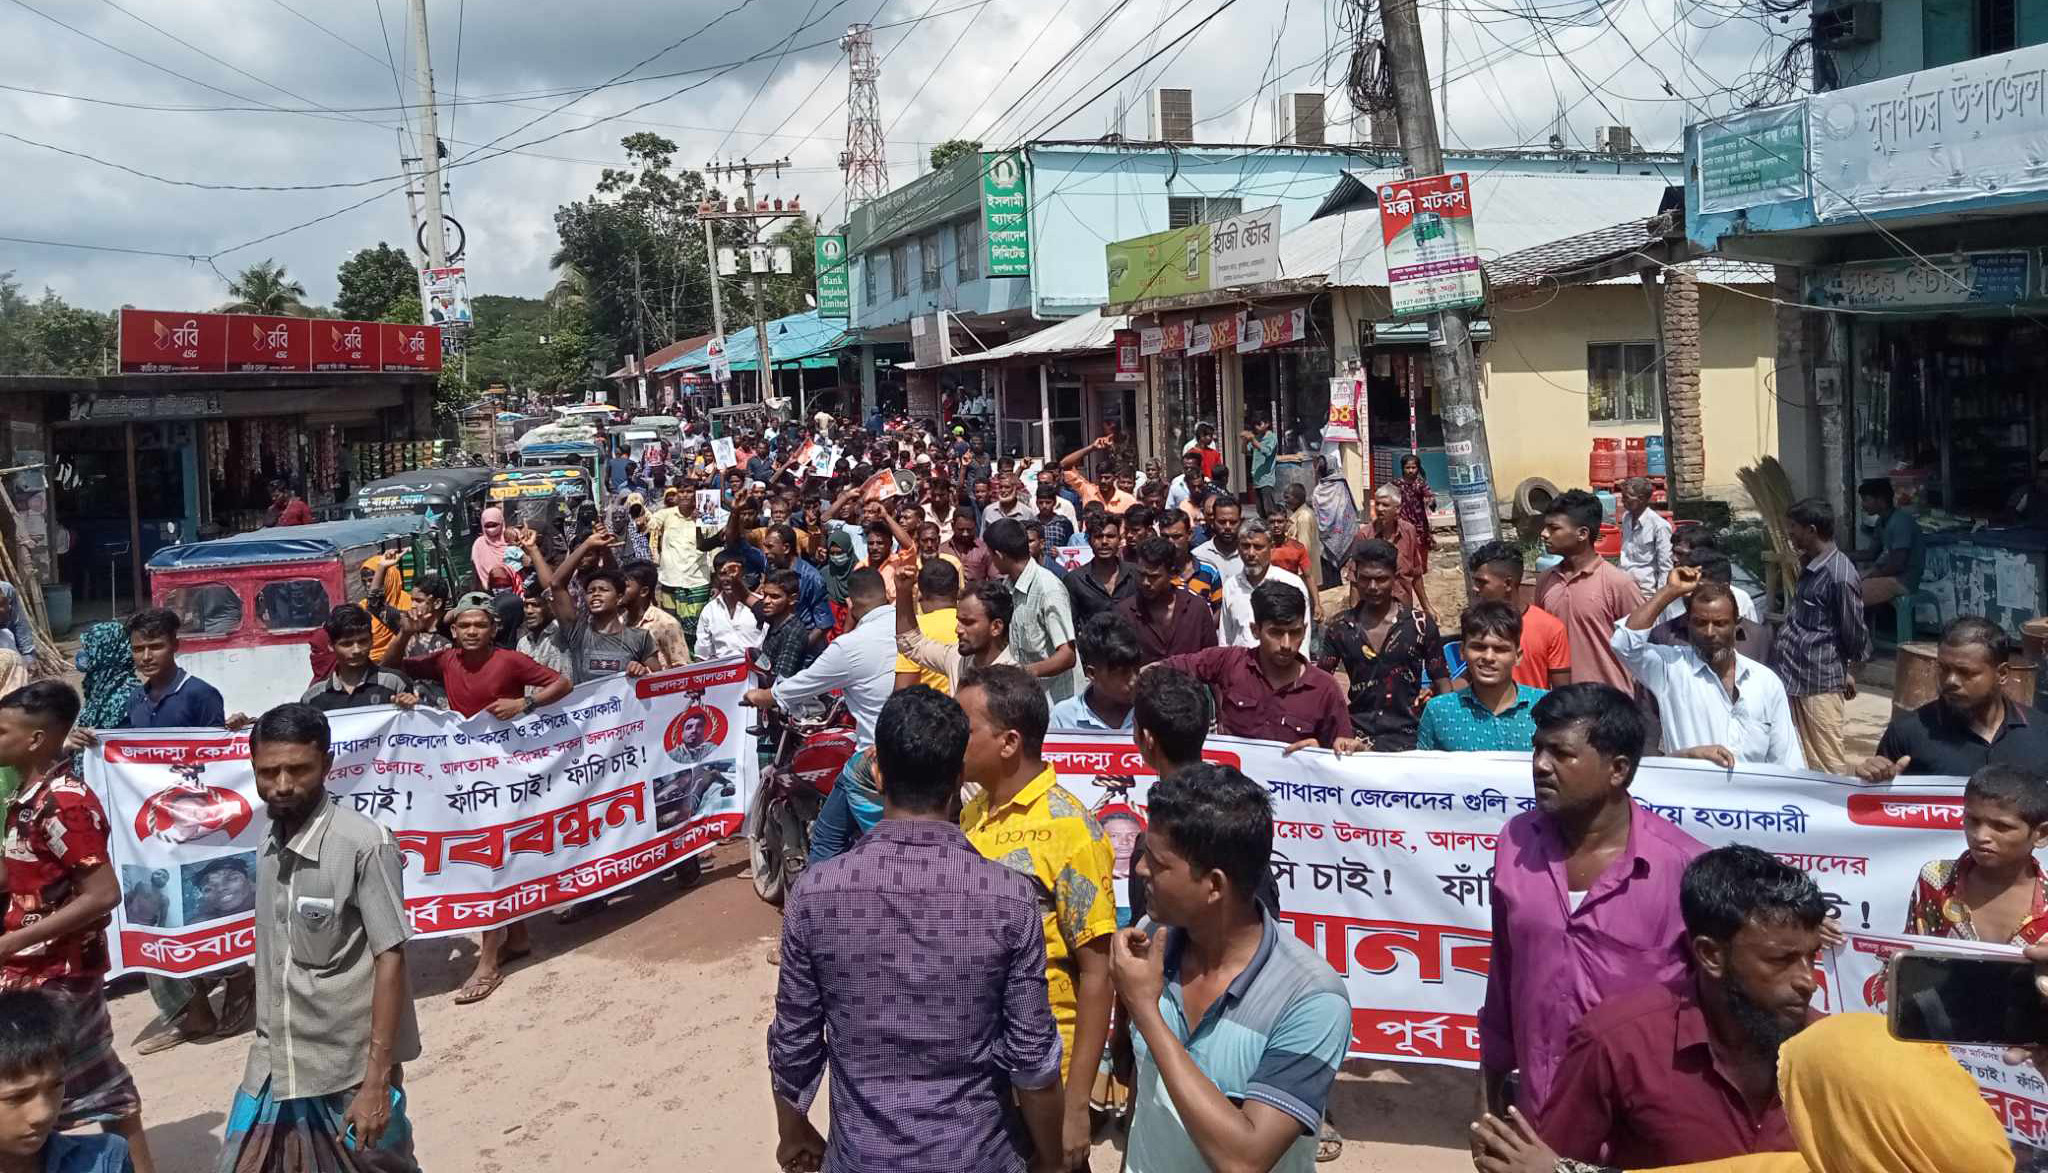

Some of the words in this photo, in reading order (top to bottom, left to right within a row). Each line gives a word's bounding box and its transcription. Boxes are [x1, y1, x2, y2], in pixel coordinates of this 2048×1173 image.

[987, 192, 1024, 208] ইসলামী
[1214, 222, 1239, 254] হাজী
[823, 276, 843, 286] Bank
[820, 298, 848, 309] Limited
[172, 319, 200, 349] রবি
[267, 323, 288, 350] রবি
[344, 326, 362, 350] রবি
[408, 331, 425, 353] রবি
[444, 780, 500, 815] ফাঁসি
[564, 753, 606, 787] ফাঁসি
[1266, 780, 1344, 805] সাধারণ
[1350, 787, 1455, 812] জেলেদের
[1462, 788, 1509, 814] গুলি
[1692, 804, 1810, 834] হত্যাকারী
[994, 829, 1052, 846] GUCCI
[447, 882, 550, 921] চরবাটা
[556, 839, 669, 894] ইউনিয়নের
[1376, 1014, 1450, 1056] পূর্ব
